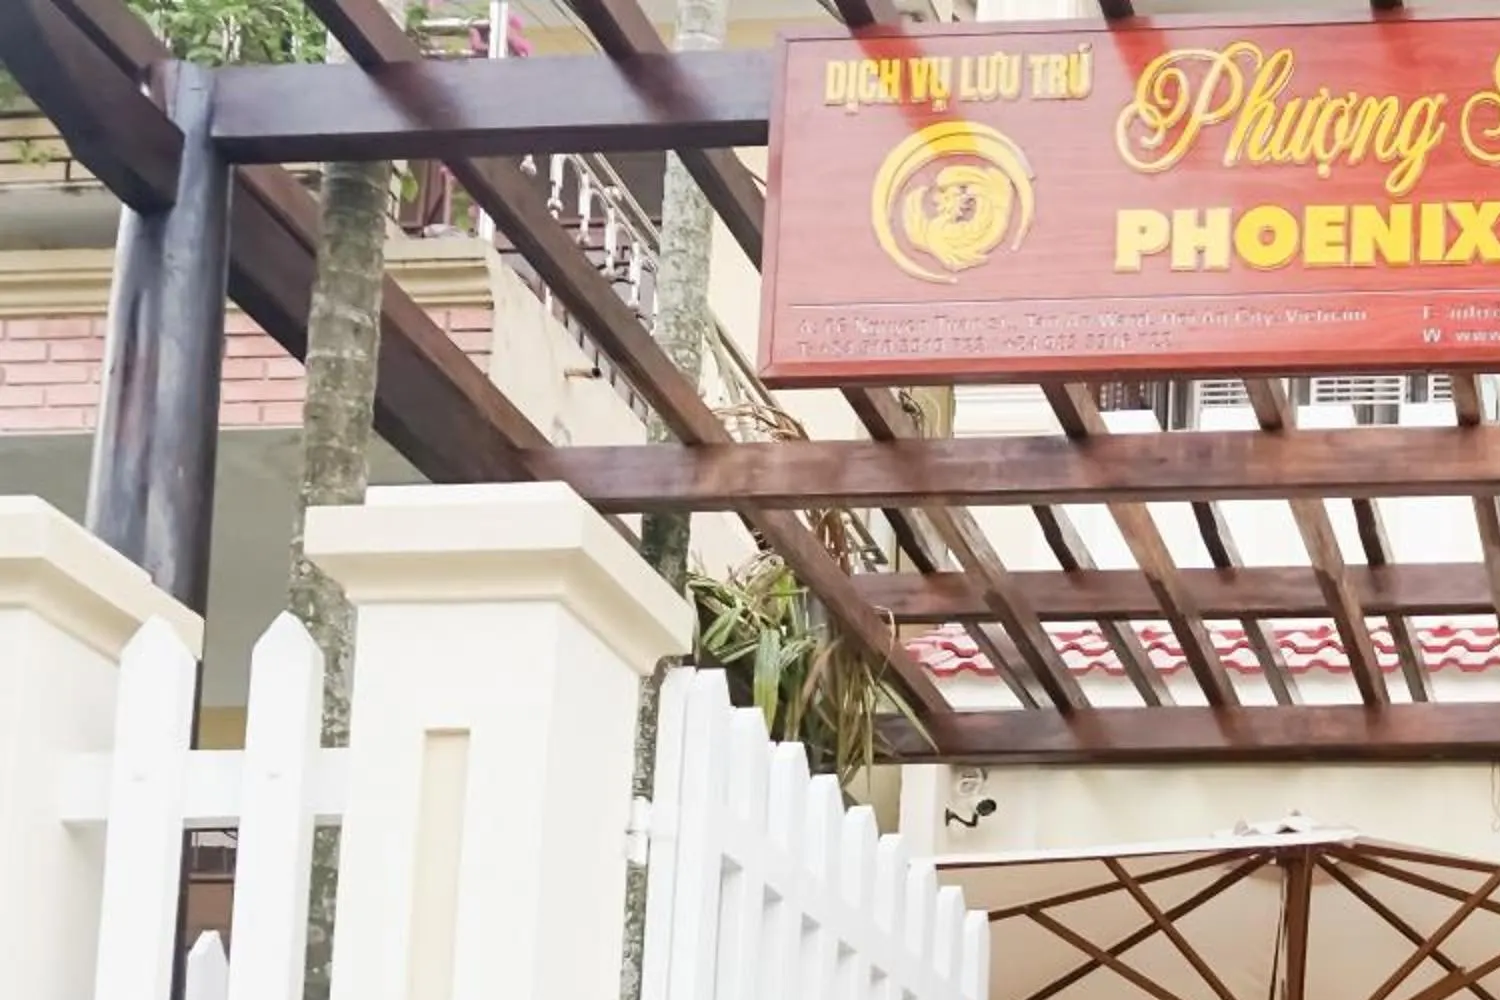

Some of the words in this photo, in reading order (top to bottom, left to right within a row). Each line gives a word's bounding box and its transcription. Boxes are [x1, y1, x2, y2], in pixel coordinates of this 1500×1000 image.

[825, 58, 901, 113] DỊCH
[908, 56, 953, 112] VỤ
[958, 50, 1022, 102] LƯU
[1116, 41, 1448, 195] Phượng
